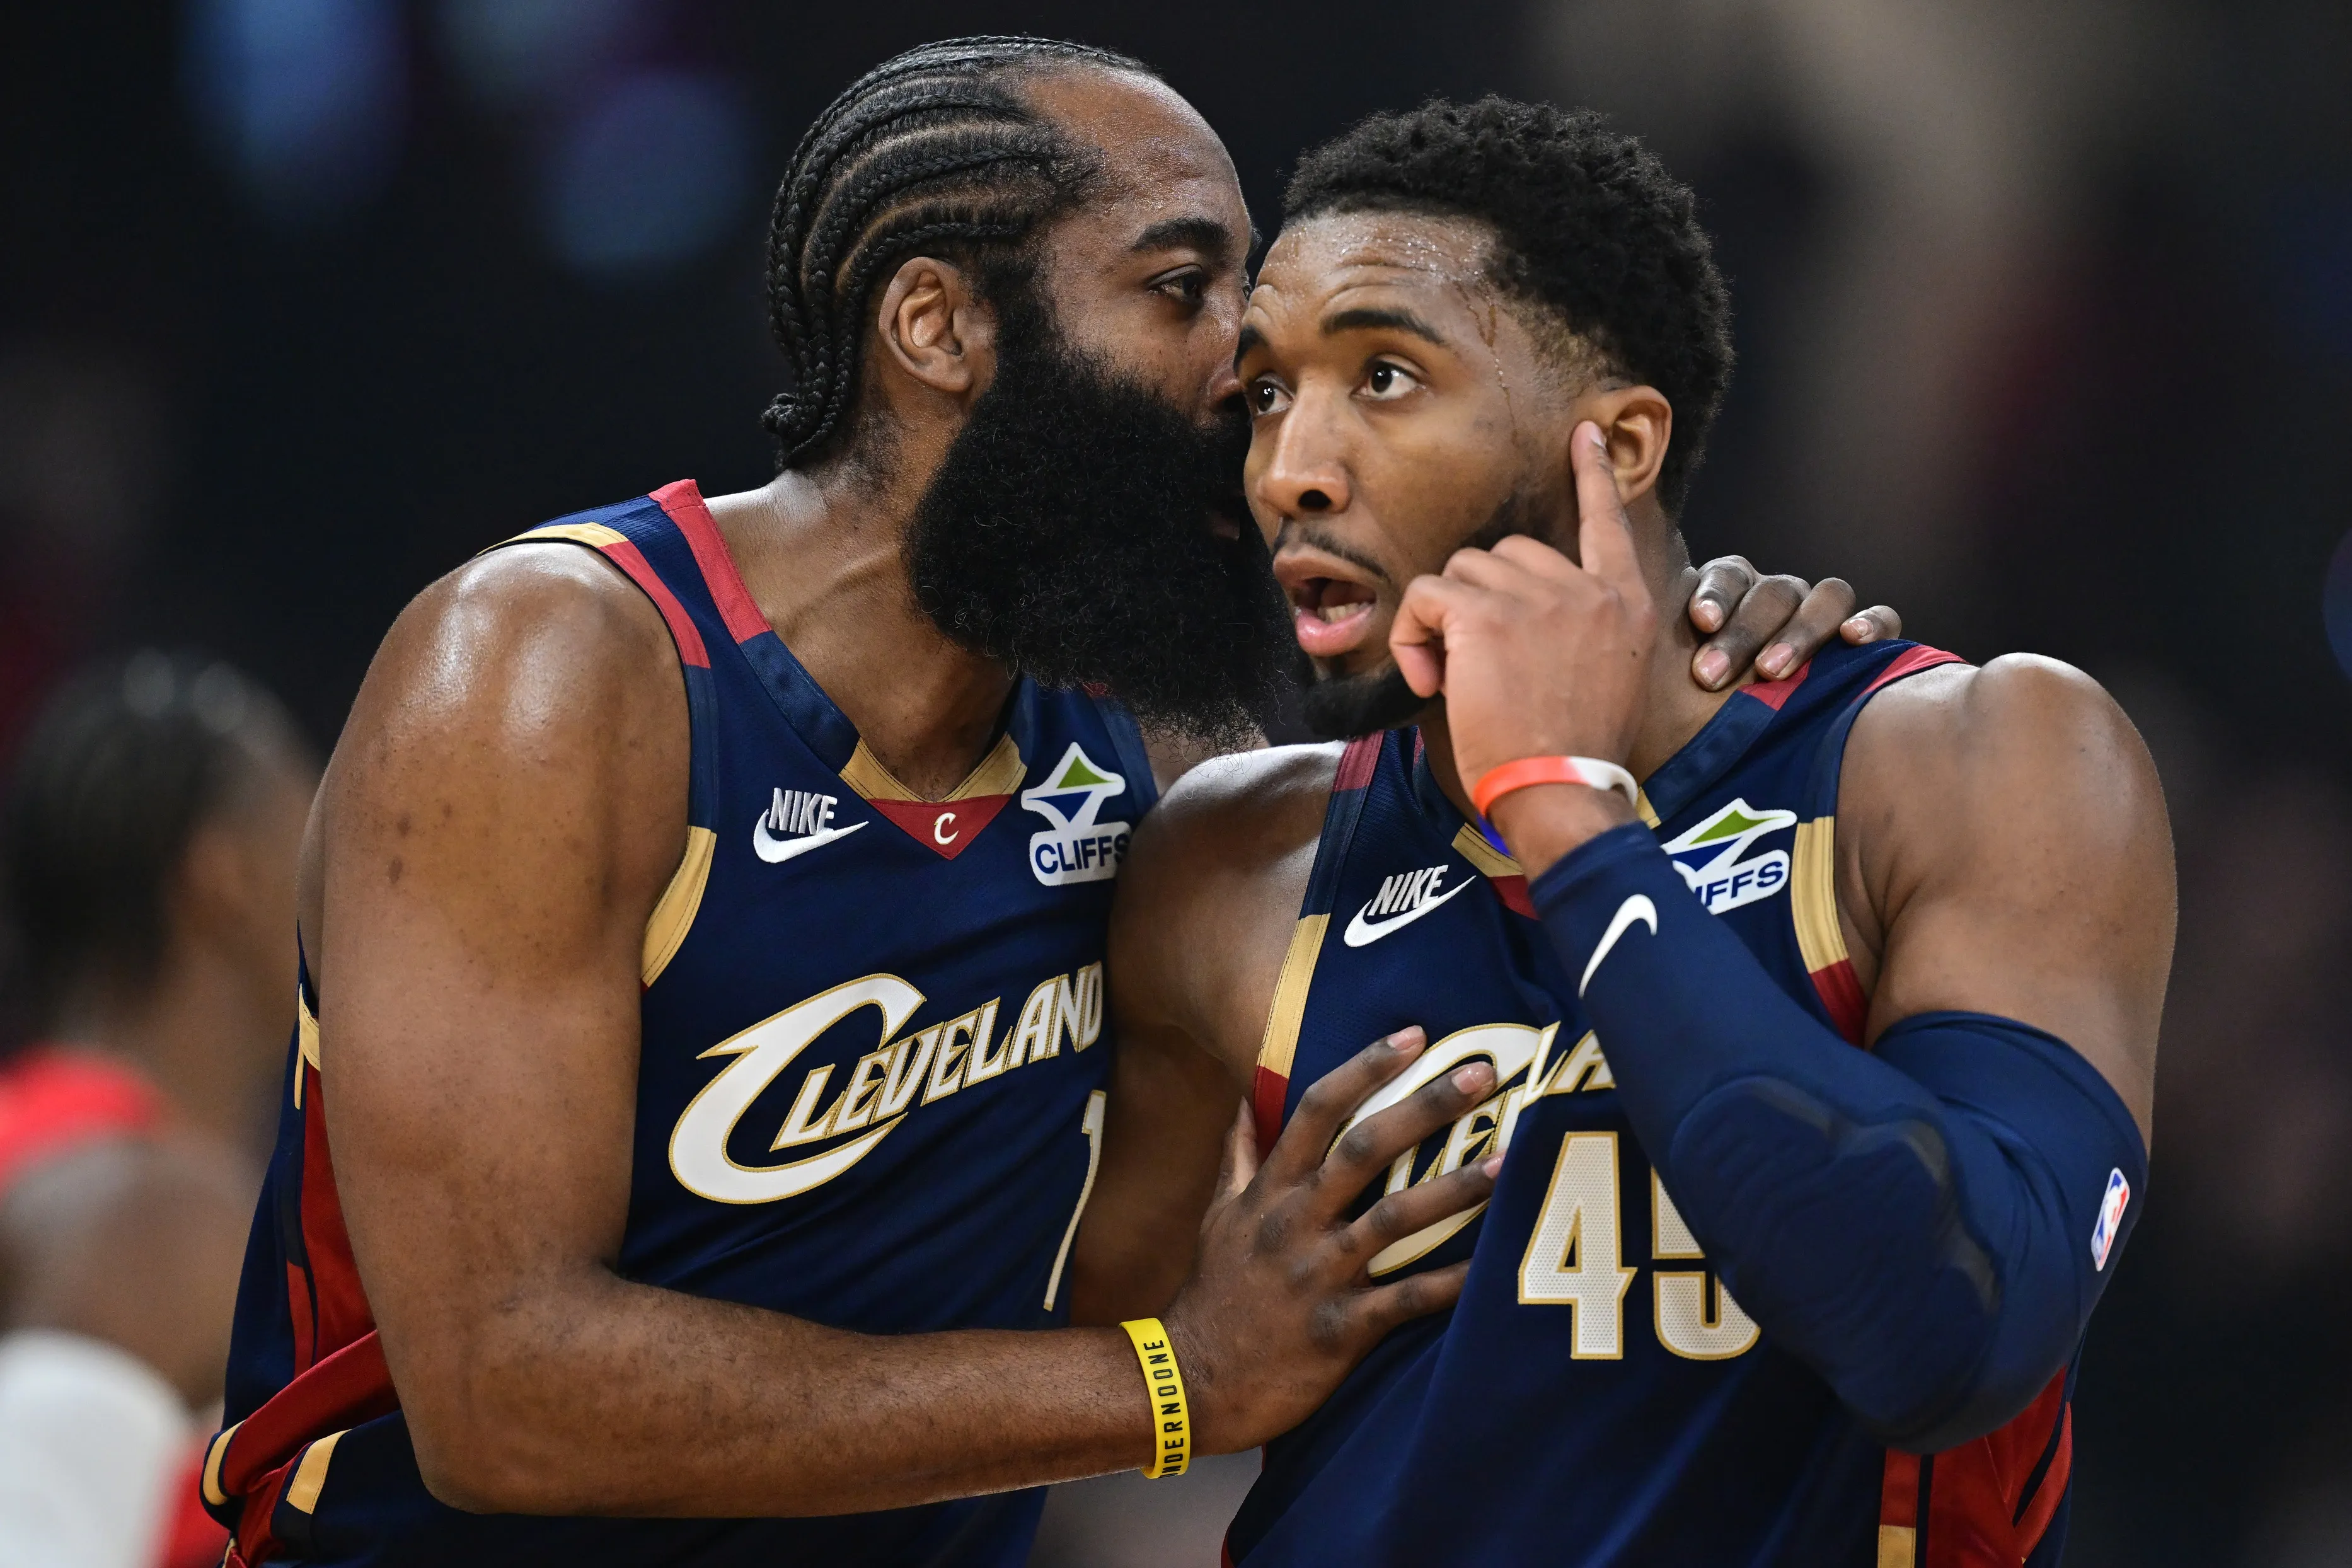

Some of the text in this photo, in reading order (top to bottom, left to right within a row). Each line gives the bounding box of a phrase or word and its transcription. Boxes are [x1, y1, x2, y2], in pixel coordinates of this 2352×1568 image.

[769, 787, 838, 835] NIKE
[934, 812, 959, 845] C
[1035, 833, 1129, 874] CLIFFS
[1367, 864, 1449, 916] NIKE
[669, 960, 1104, 1204] CLEVELAND
